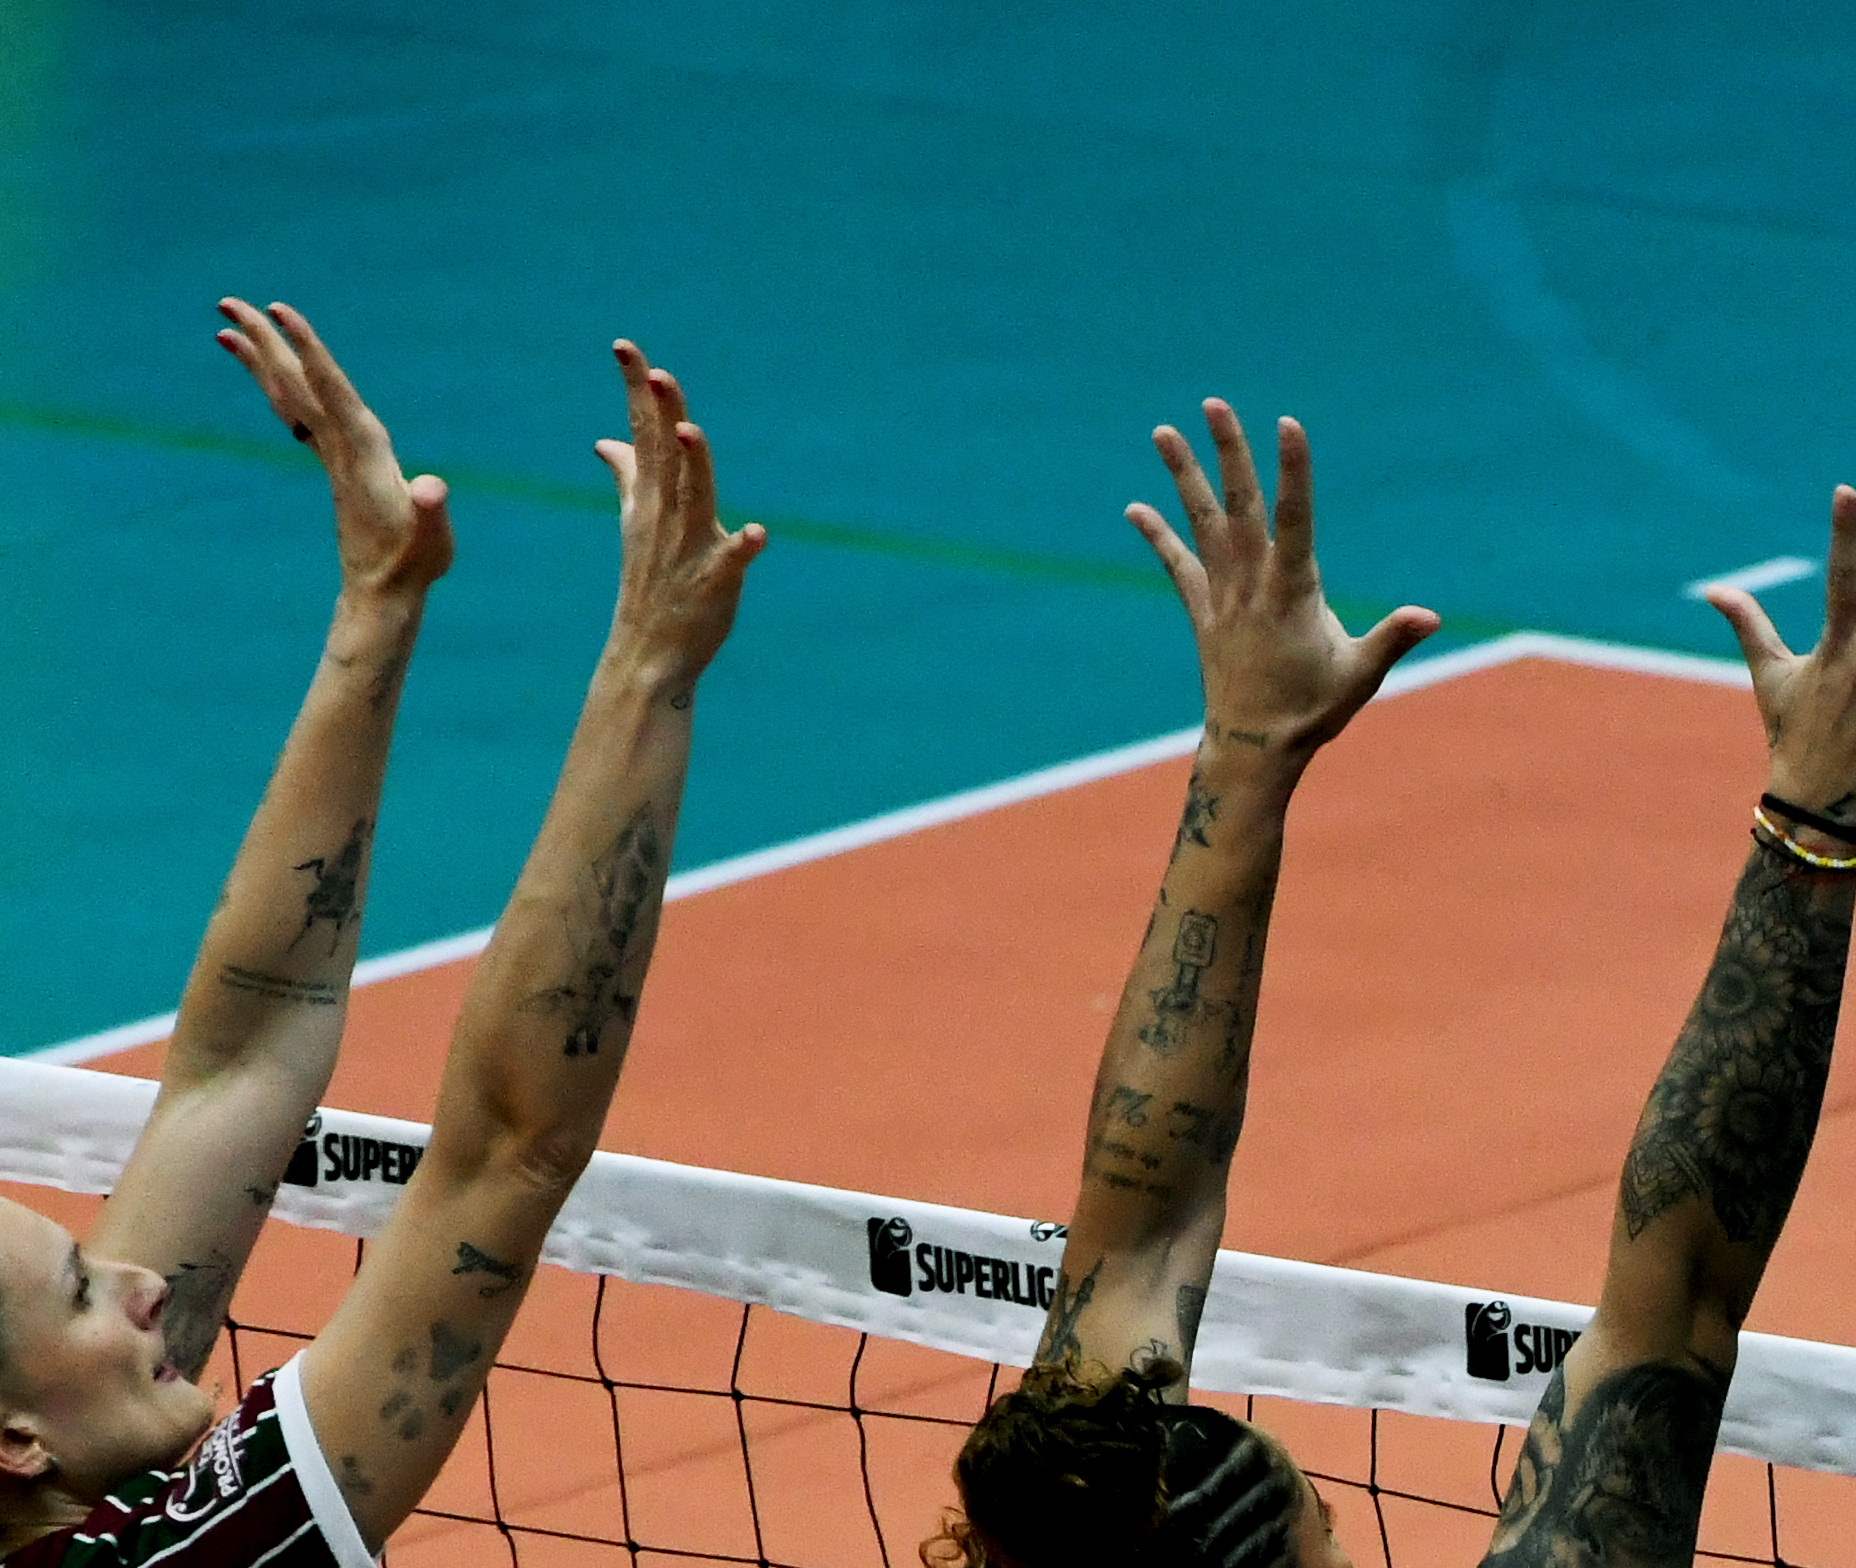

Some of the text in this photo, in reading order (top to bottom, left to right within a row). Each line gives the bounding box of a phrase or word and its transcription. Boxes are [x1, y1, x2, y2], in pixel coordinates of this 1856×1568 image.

[323, 1133, 424, 1184] SUPER
[916, 1242, 1056, 1310] SUPERLIG
[1514, 1324, 1581, 1374] SUP
